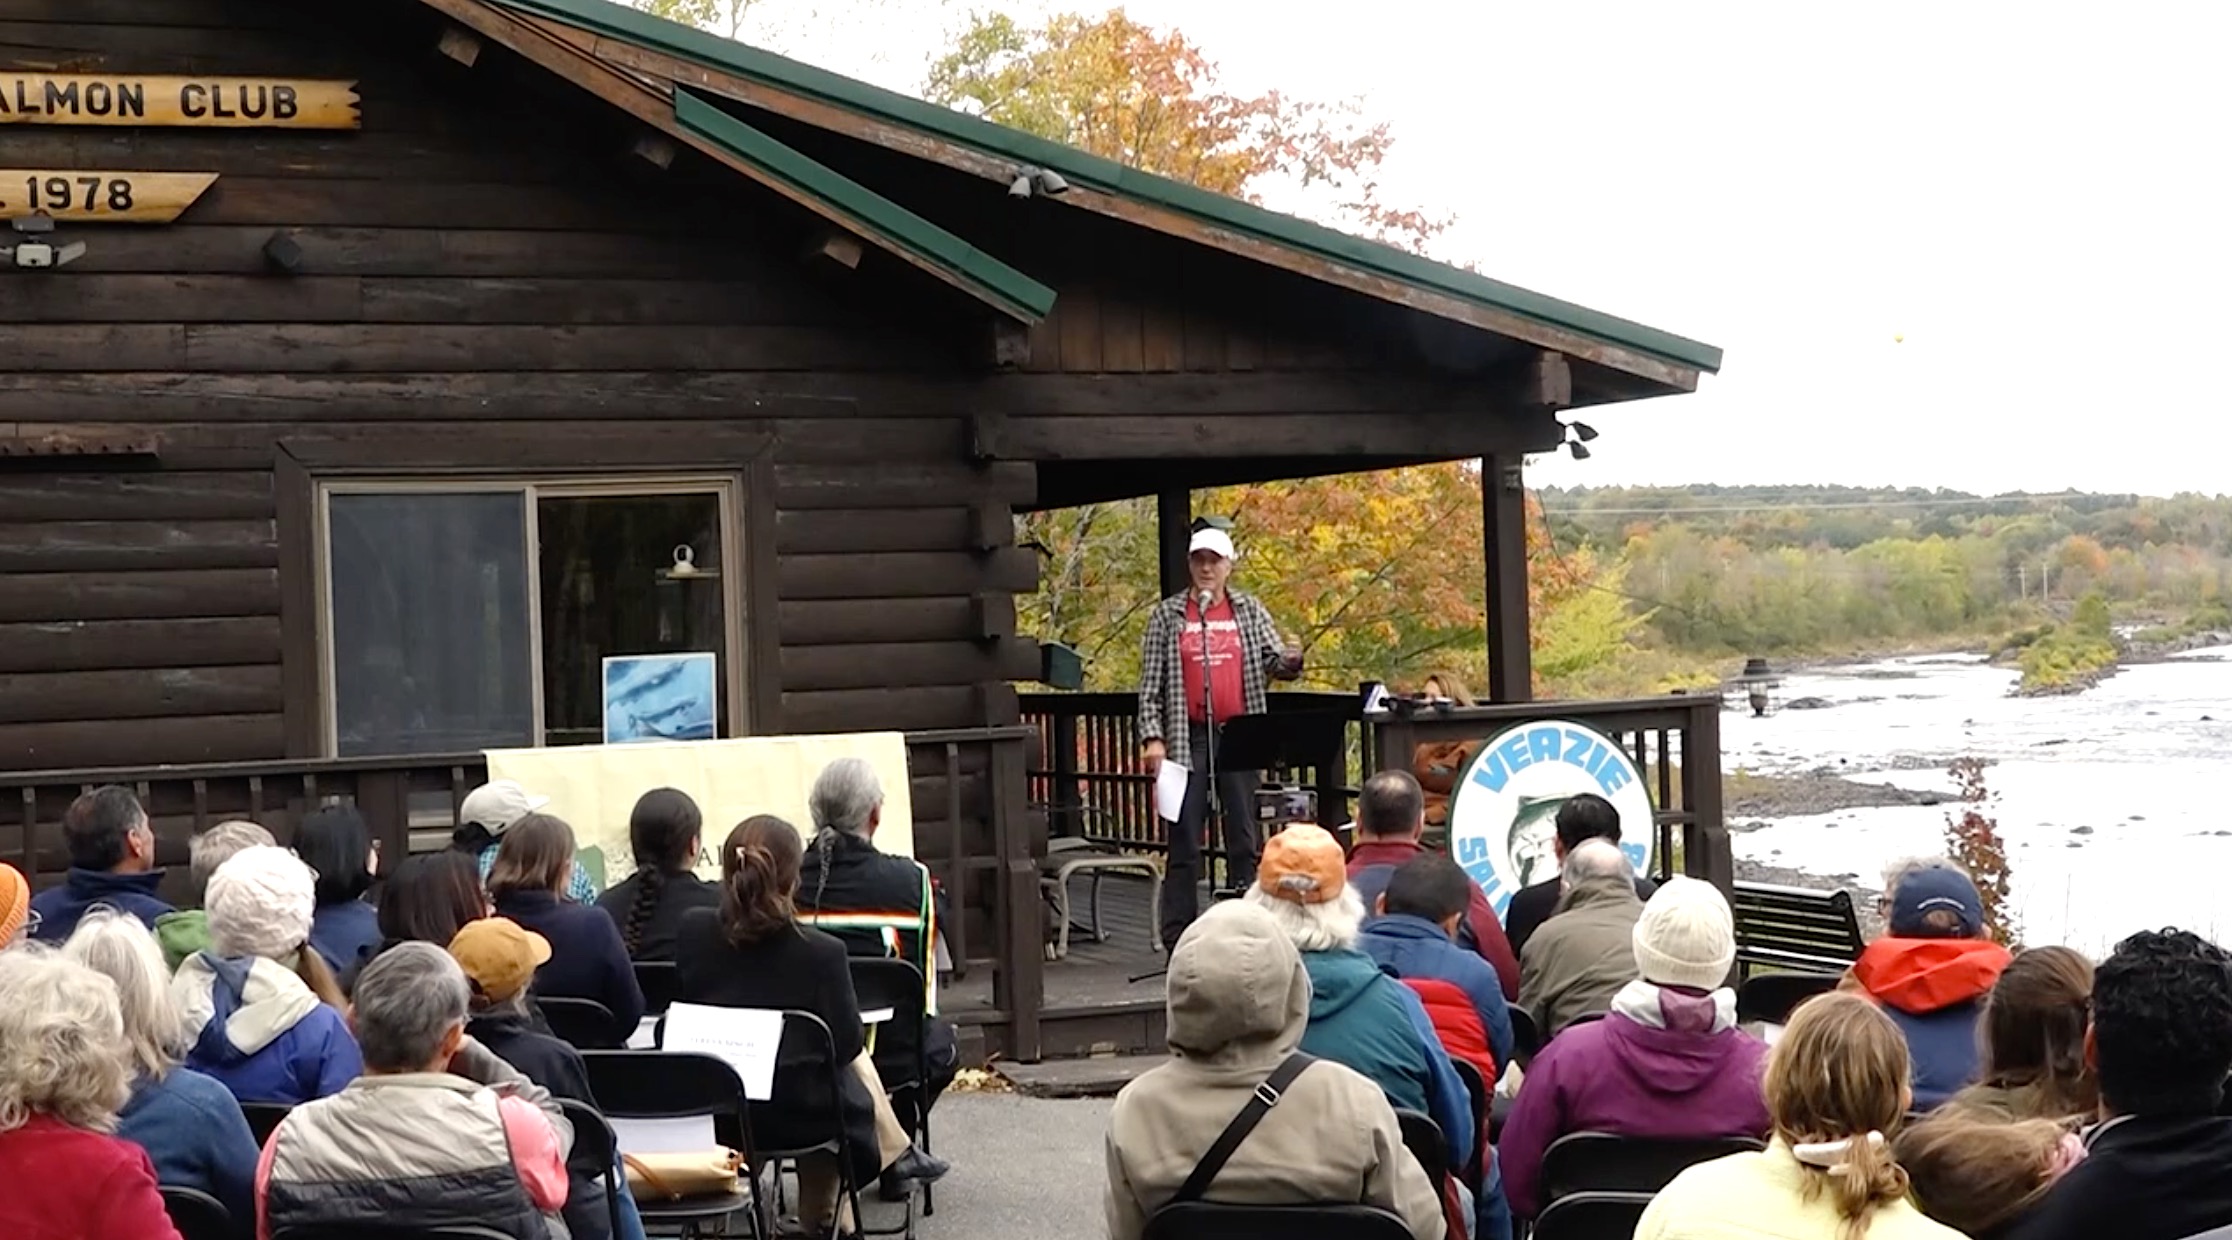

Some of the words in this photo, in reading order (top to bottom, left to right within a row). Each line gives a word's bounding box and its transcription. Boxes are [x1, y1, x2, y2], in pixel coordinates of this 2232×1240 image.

[180, 84, 298, 119] CLUB
[26, 176, 133, 213] 1978
[1472, 727, 1633, 797] VEAZIE
